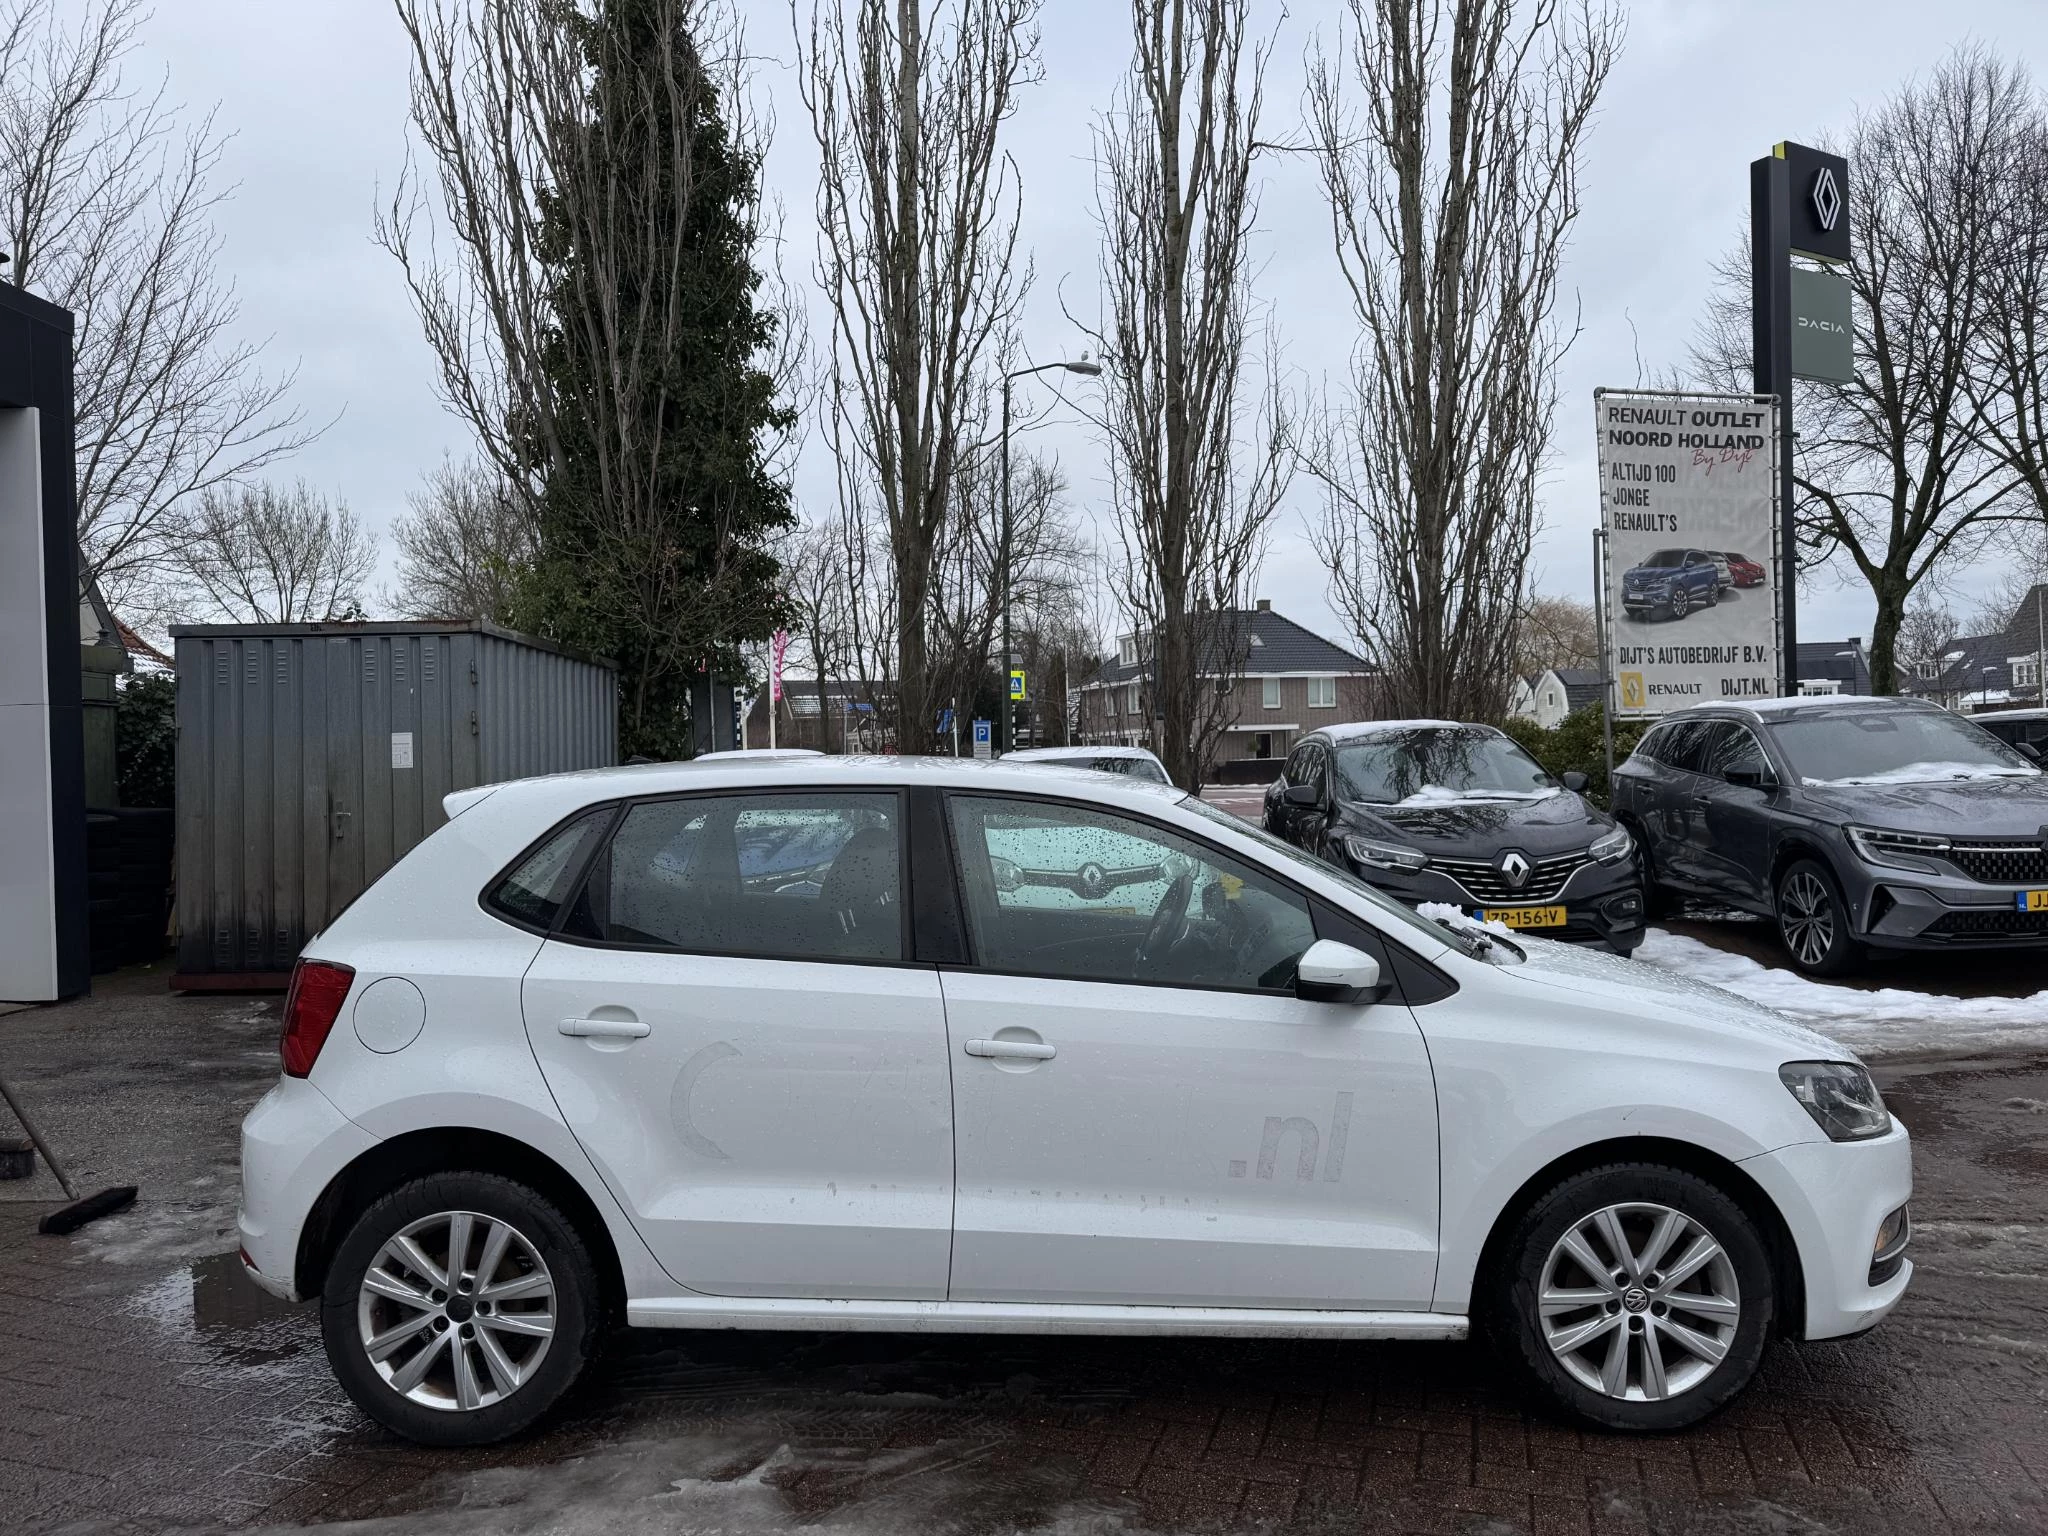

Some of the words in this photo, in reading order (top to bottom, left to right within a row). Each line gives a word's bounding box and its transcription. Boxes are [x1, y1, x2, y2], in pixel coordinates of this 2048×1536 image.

[1798, 316, 1845, 334] DACIA
[1608, 407, 1686, 426] RENAULT
[1691, 410, 1765, 428] OUTLET
[1609, 430, 1672, 447] NOORD
[1678, 433, 1764, 450] HOLLAND
[1691, 448, 1716, 476] By
[1612, 462, 1651, 482] ALTIJD
[1655, 464, 1676, 483] 100
[1613, 487, 1650, 506] JONGE
[1614, 512, 1677, 532] RENAULT'S
[1620, 646, 1655, 664] DIJT'S
[1658, 646, 1739, 664] AUTOBEDRIJF
[1743, 645, 1767, 663] B.V.
[1648, 683, 1702, 695] RENAULT
[1721, 677, 1769, 696] DIJT.NL
[978, 728, 986, 741] P
[1228, 1091, 1354, 1182] .nl
